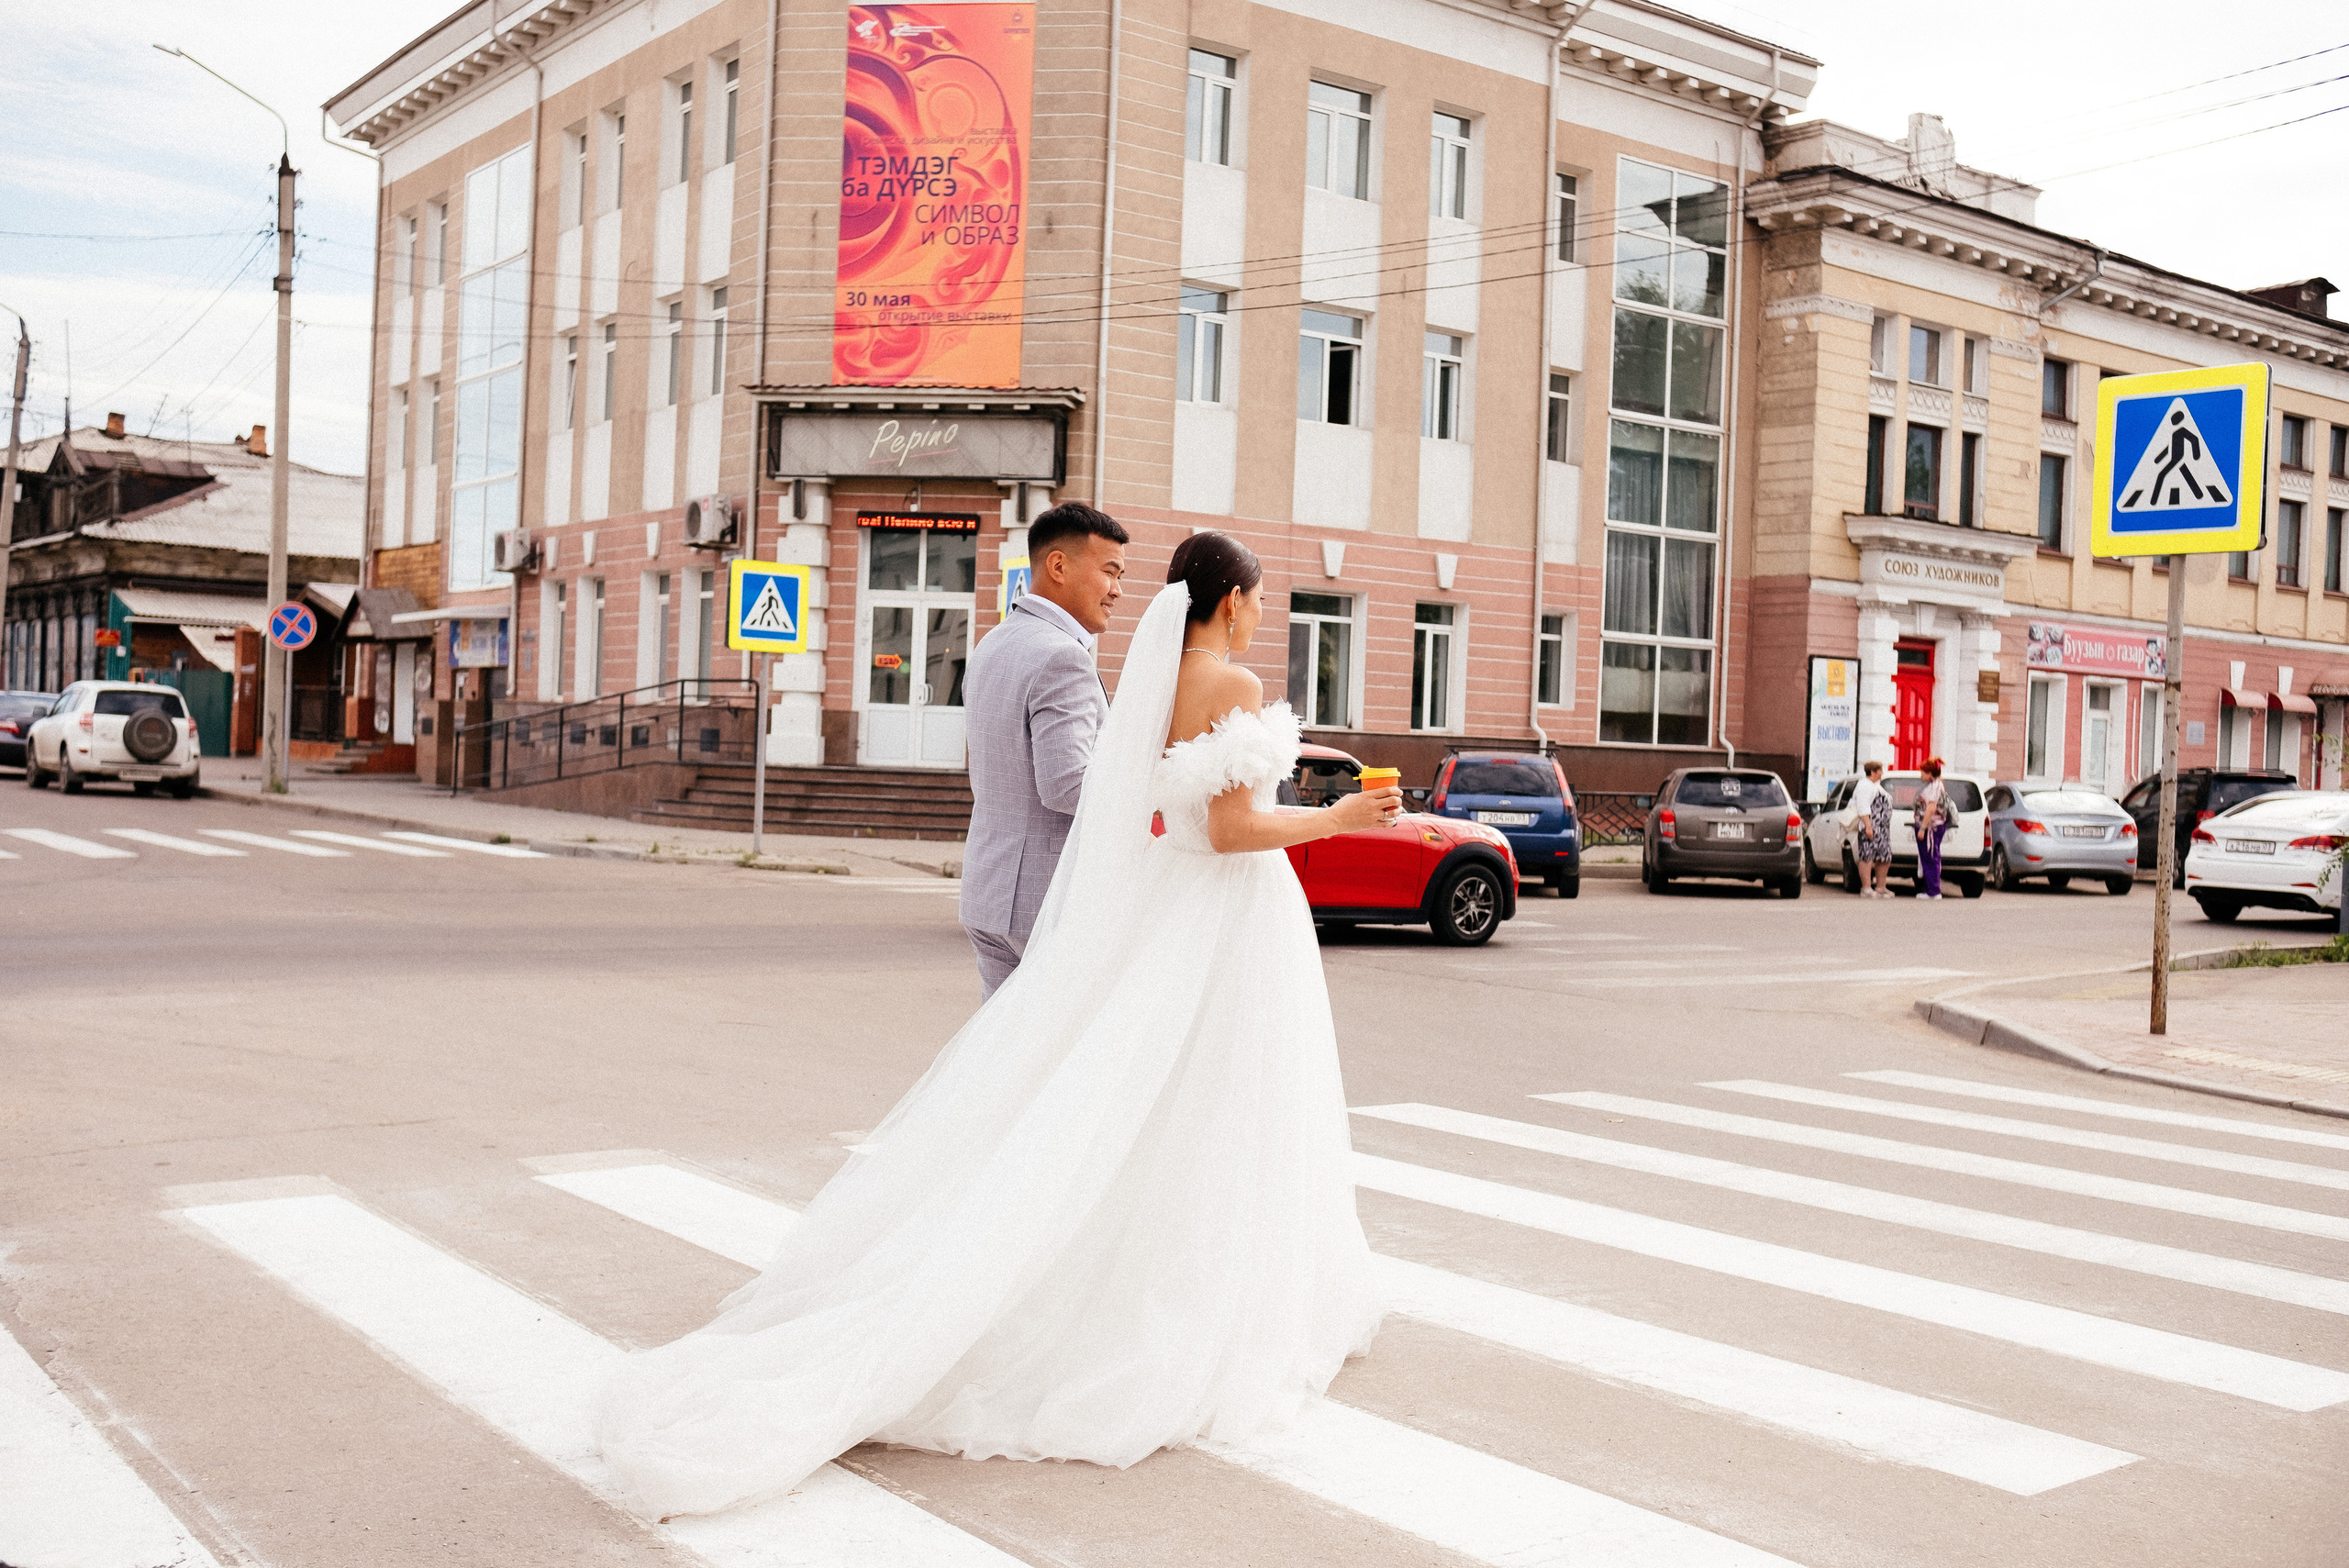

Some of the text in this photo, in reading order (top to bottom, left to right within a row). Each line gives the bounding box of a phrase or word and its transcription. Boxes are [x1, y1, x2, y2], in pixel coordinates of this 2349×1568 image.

[857, 156, 959, 180] ТЭМДЭГ
[842, 177, 869, 196] ба
[915, 204, 1019, 224] СИМВОЛ
[921, 226, 1019, 245] и ОБРАЗ
[845, 292, 911, 306] 30 мая
[878, 311, 1011, 323] открытие выставки
[869, 419, 959, 467] Pepino
[1885, 559, 1999, 587] СОЮЗ ХУДОЖНИКОВ
[2065, 633, 2145, 670] Буузын газар
